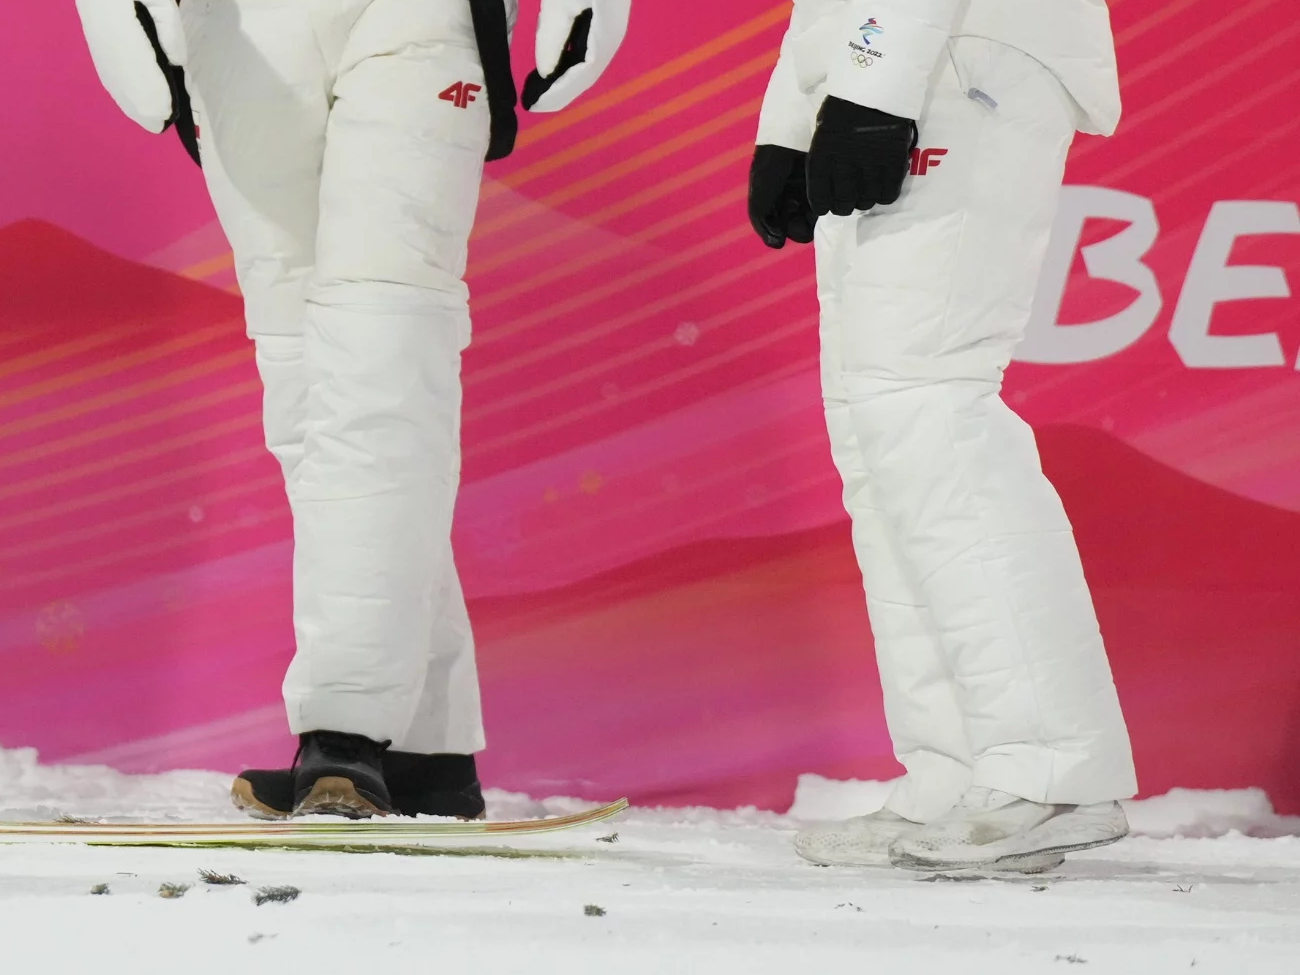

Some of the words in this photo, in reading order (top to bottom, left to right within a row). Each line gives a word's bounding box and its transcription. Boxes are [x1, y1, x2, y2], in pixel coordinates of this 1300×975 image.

[866, 48, 883, 58] 2022
[438, 81, 482, 109] 4F
[1008, 184, 1300, 372] BE
